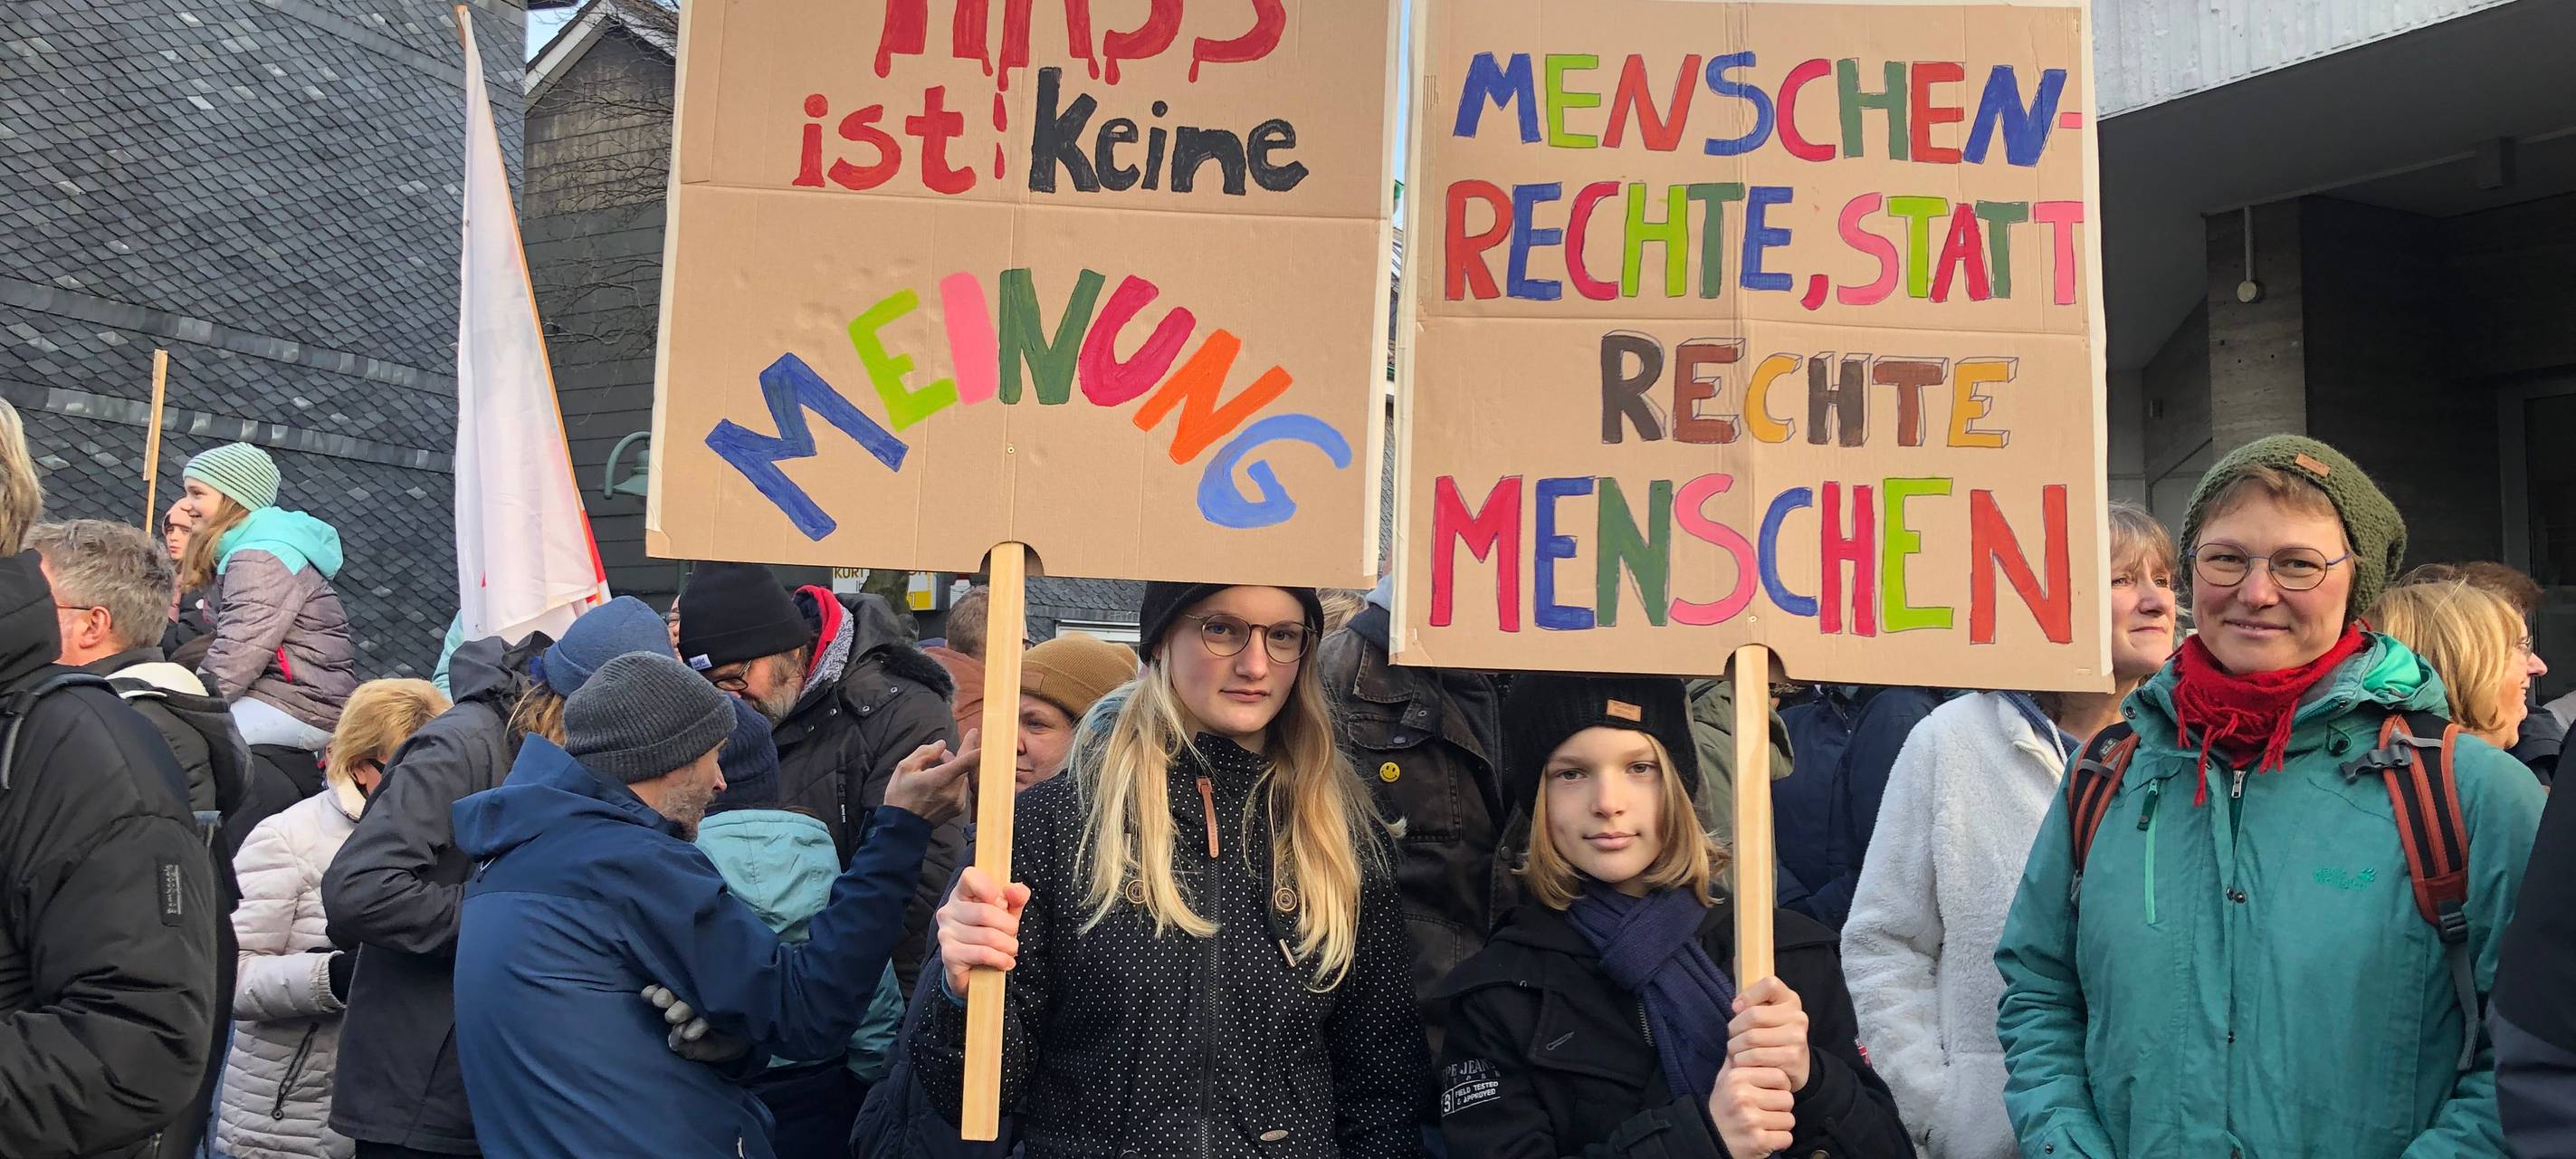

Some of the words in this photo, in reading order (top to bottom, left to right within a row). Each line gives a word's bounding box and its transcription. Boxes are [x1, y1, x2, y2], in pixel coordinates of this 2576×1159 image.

[792, 85, 977, 195] ist
[1453, 51, 2083, 168] MENSCHEN-
[1837, 192, 2085, 307] STATT
[704, 268, 1353, 542] MEINUNG
[1601, 330, 2019, 449] RECHTE
[1430, 473, 2073, 646] MENSCHEN
[1473, 1081, 1499, 1091] TESTED
